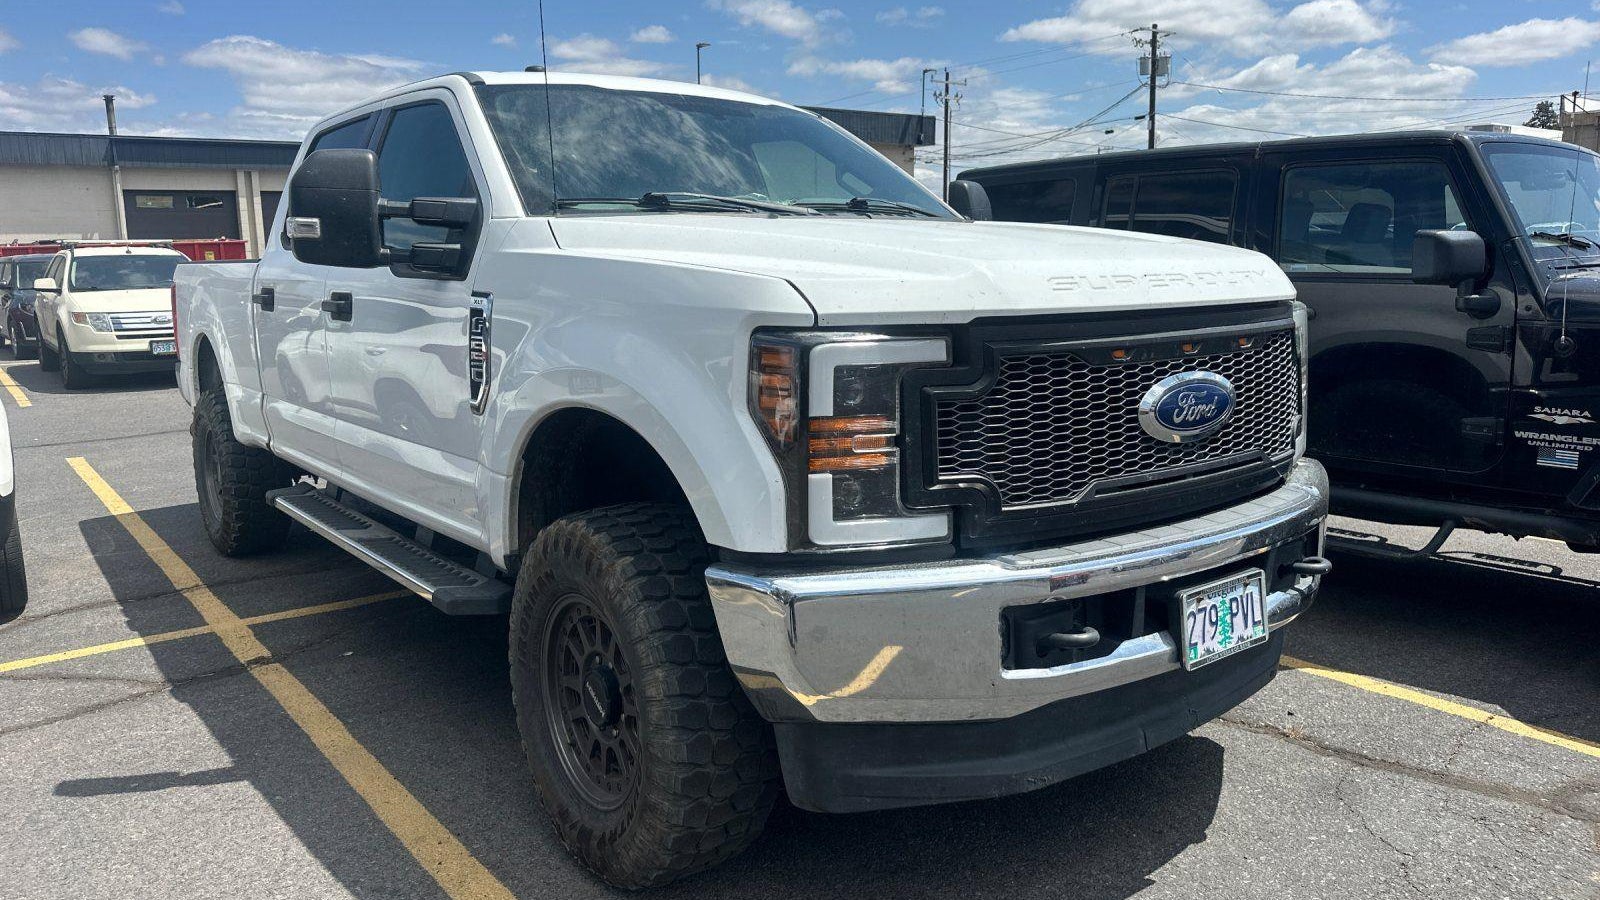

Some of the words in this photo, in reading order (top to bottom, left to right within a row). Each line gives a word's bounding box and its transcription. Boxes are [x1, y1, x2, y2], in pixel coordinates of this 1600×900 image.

[1173, 391, 1218, 423] Ford
[1533, 406, 1592, 417] SAHARA
[1514, 430, 1600, 445] WRANGLER
[1527, 440, 1593, 451] UNLIMITED
[1187, 603, 1219, 647] 279
[1229, 591, 1261, 633] PVL
